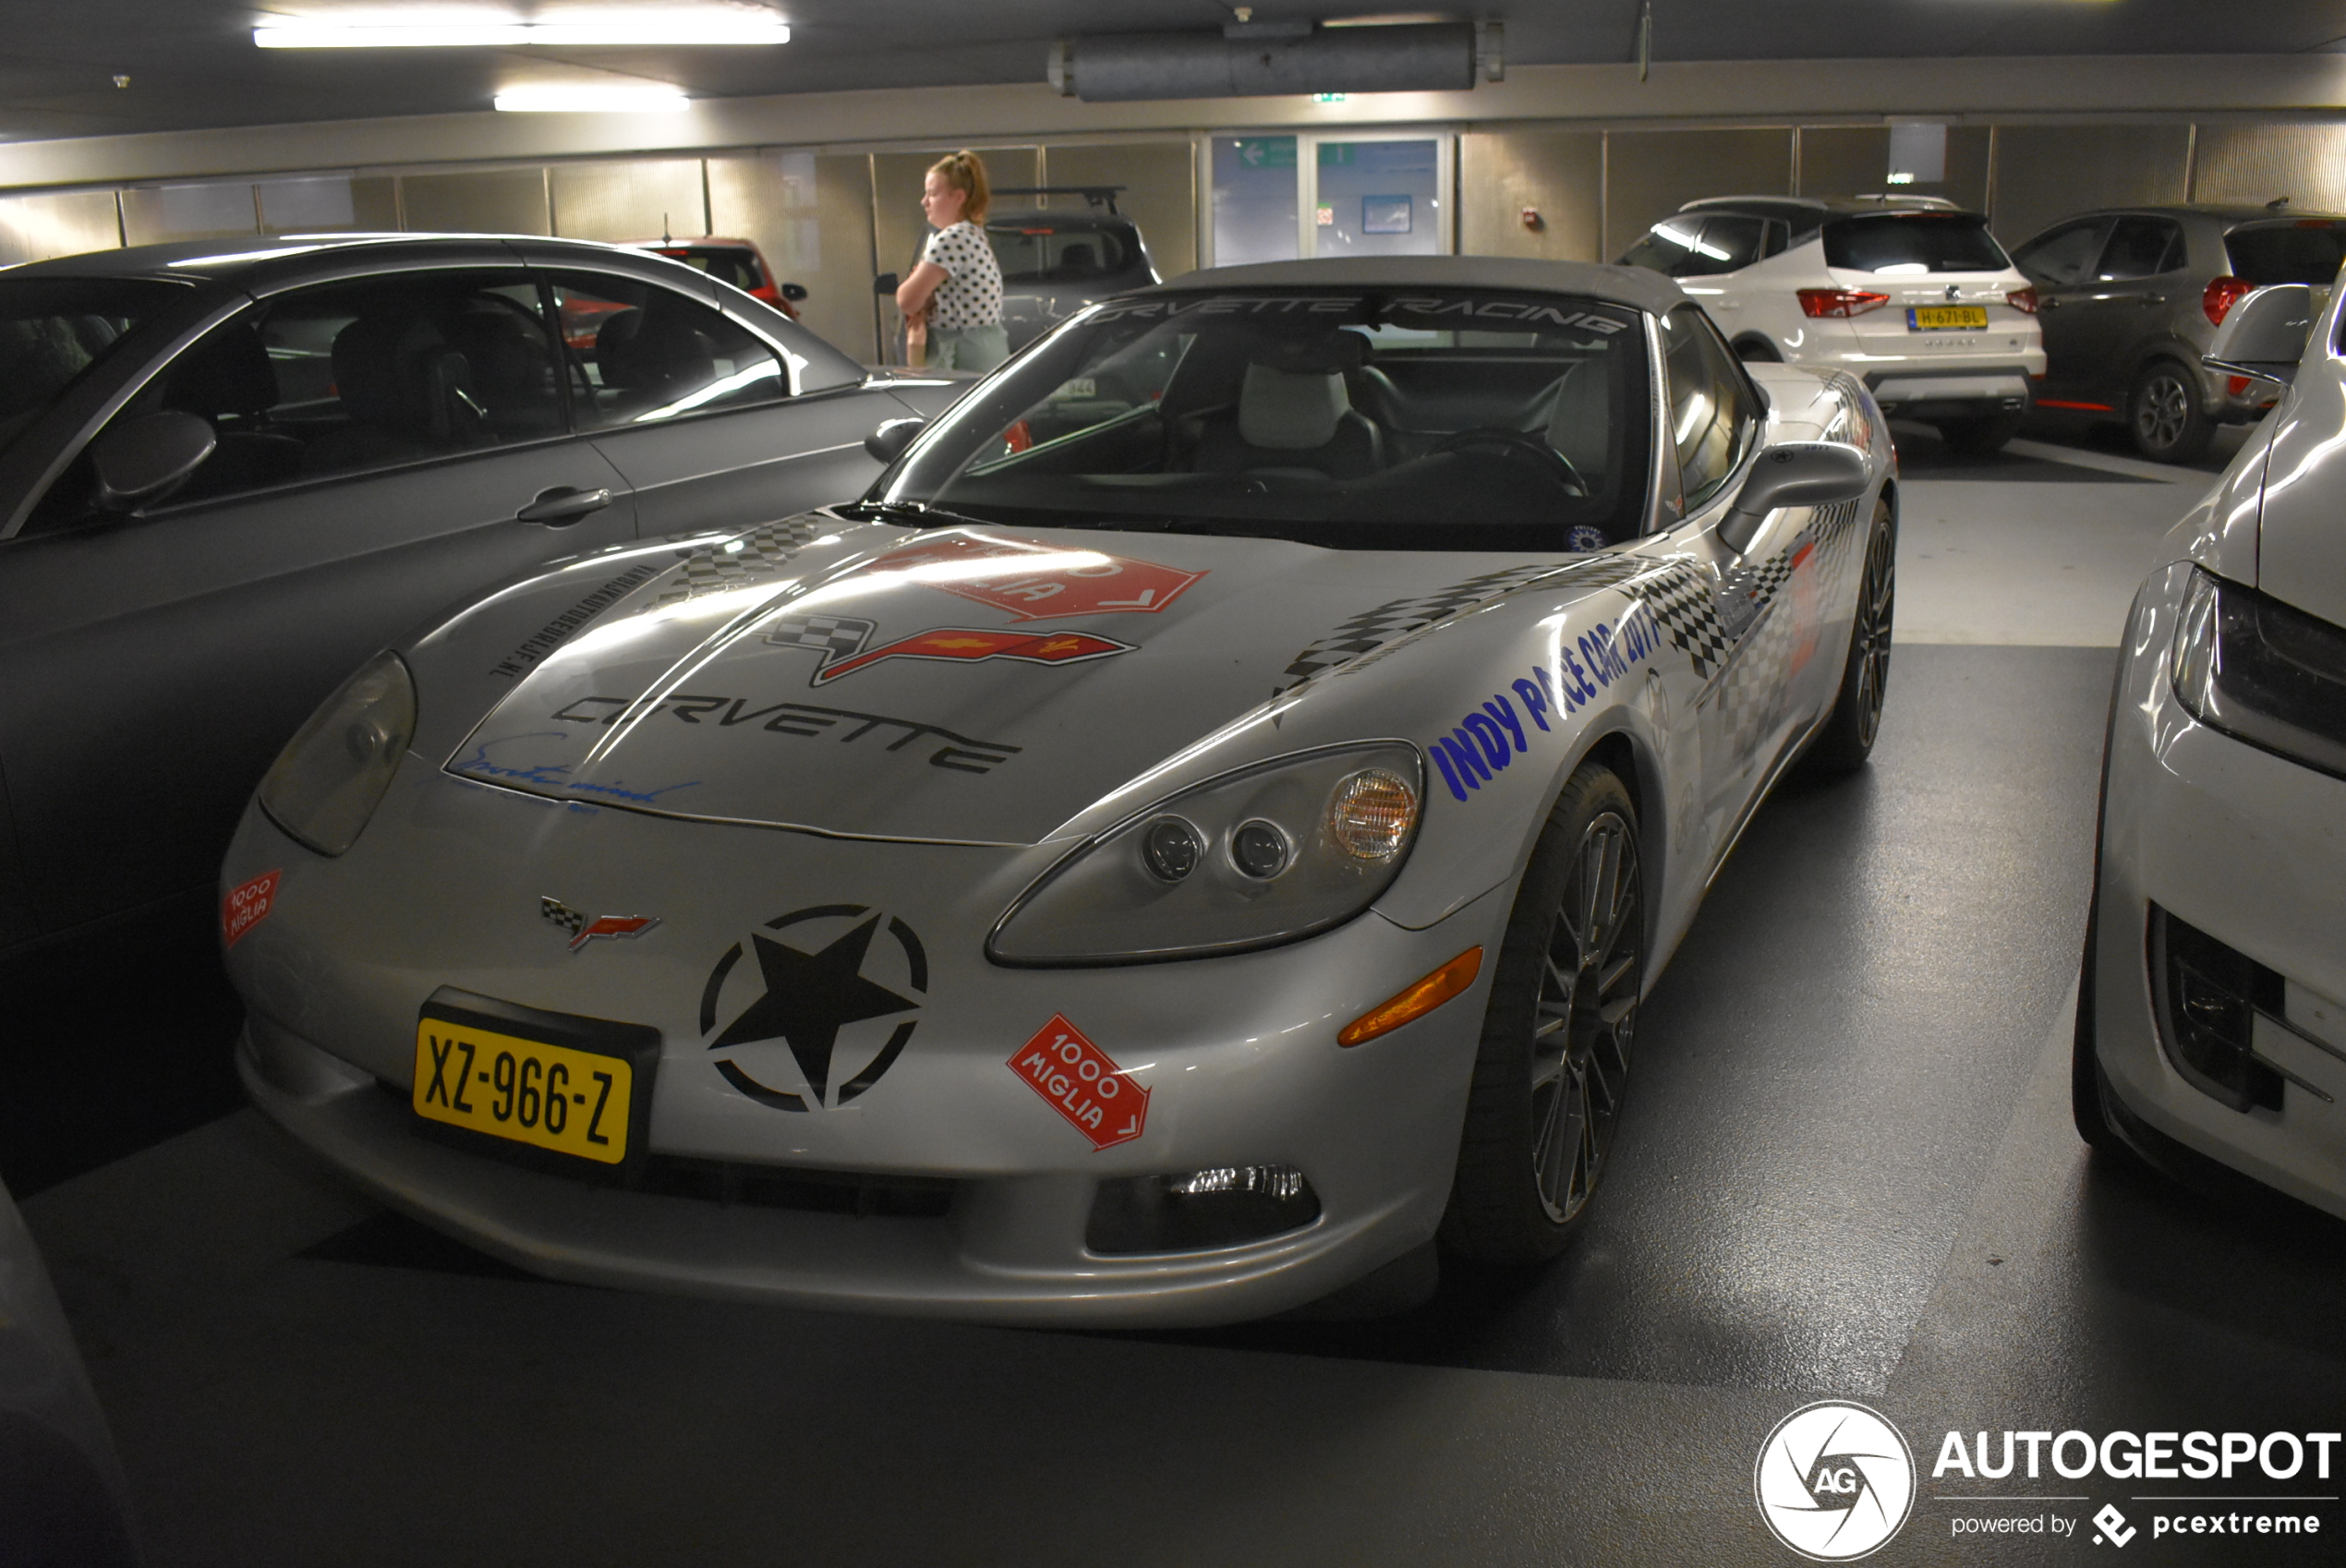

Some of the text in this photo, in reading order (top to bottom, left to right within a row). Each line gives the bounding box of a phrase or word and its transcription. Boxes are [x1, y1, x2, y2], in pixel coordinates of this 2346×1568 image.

[1079, 297, 1627, 335] ORVETTE RACING
[551, 695, 1022, 775] CORVETTE
[1429, 694, 1528, 802] INDY
[1512, 646, 1597, 732] PACE
[1578, 623, 1627, 687] CAR
[231, 898, 267, 936] MIGLIA
[232, 879, 271, 911] 1000
[425, 1034, 614, 1146] XZ-966-Z
[1022, 1052, 1103, 1129] MIGLIA
[1051, 1034, 1119, 1099] 1000
